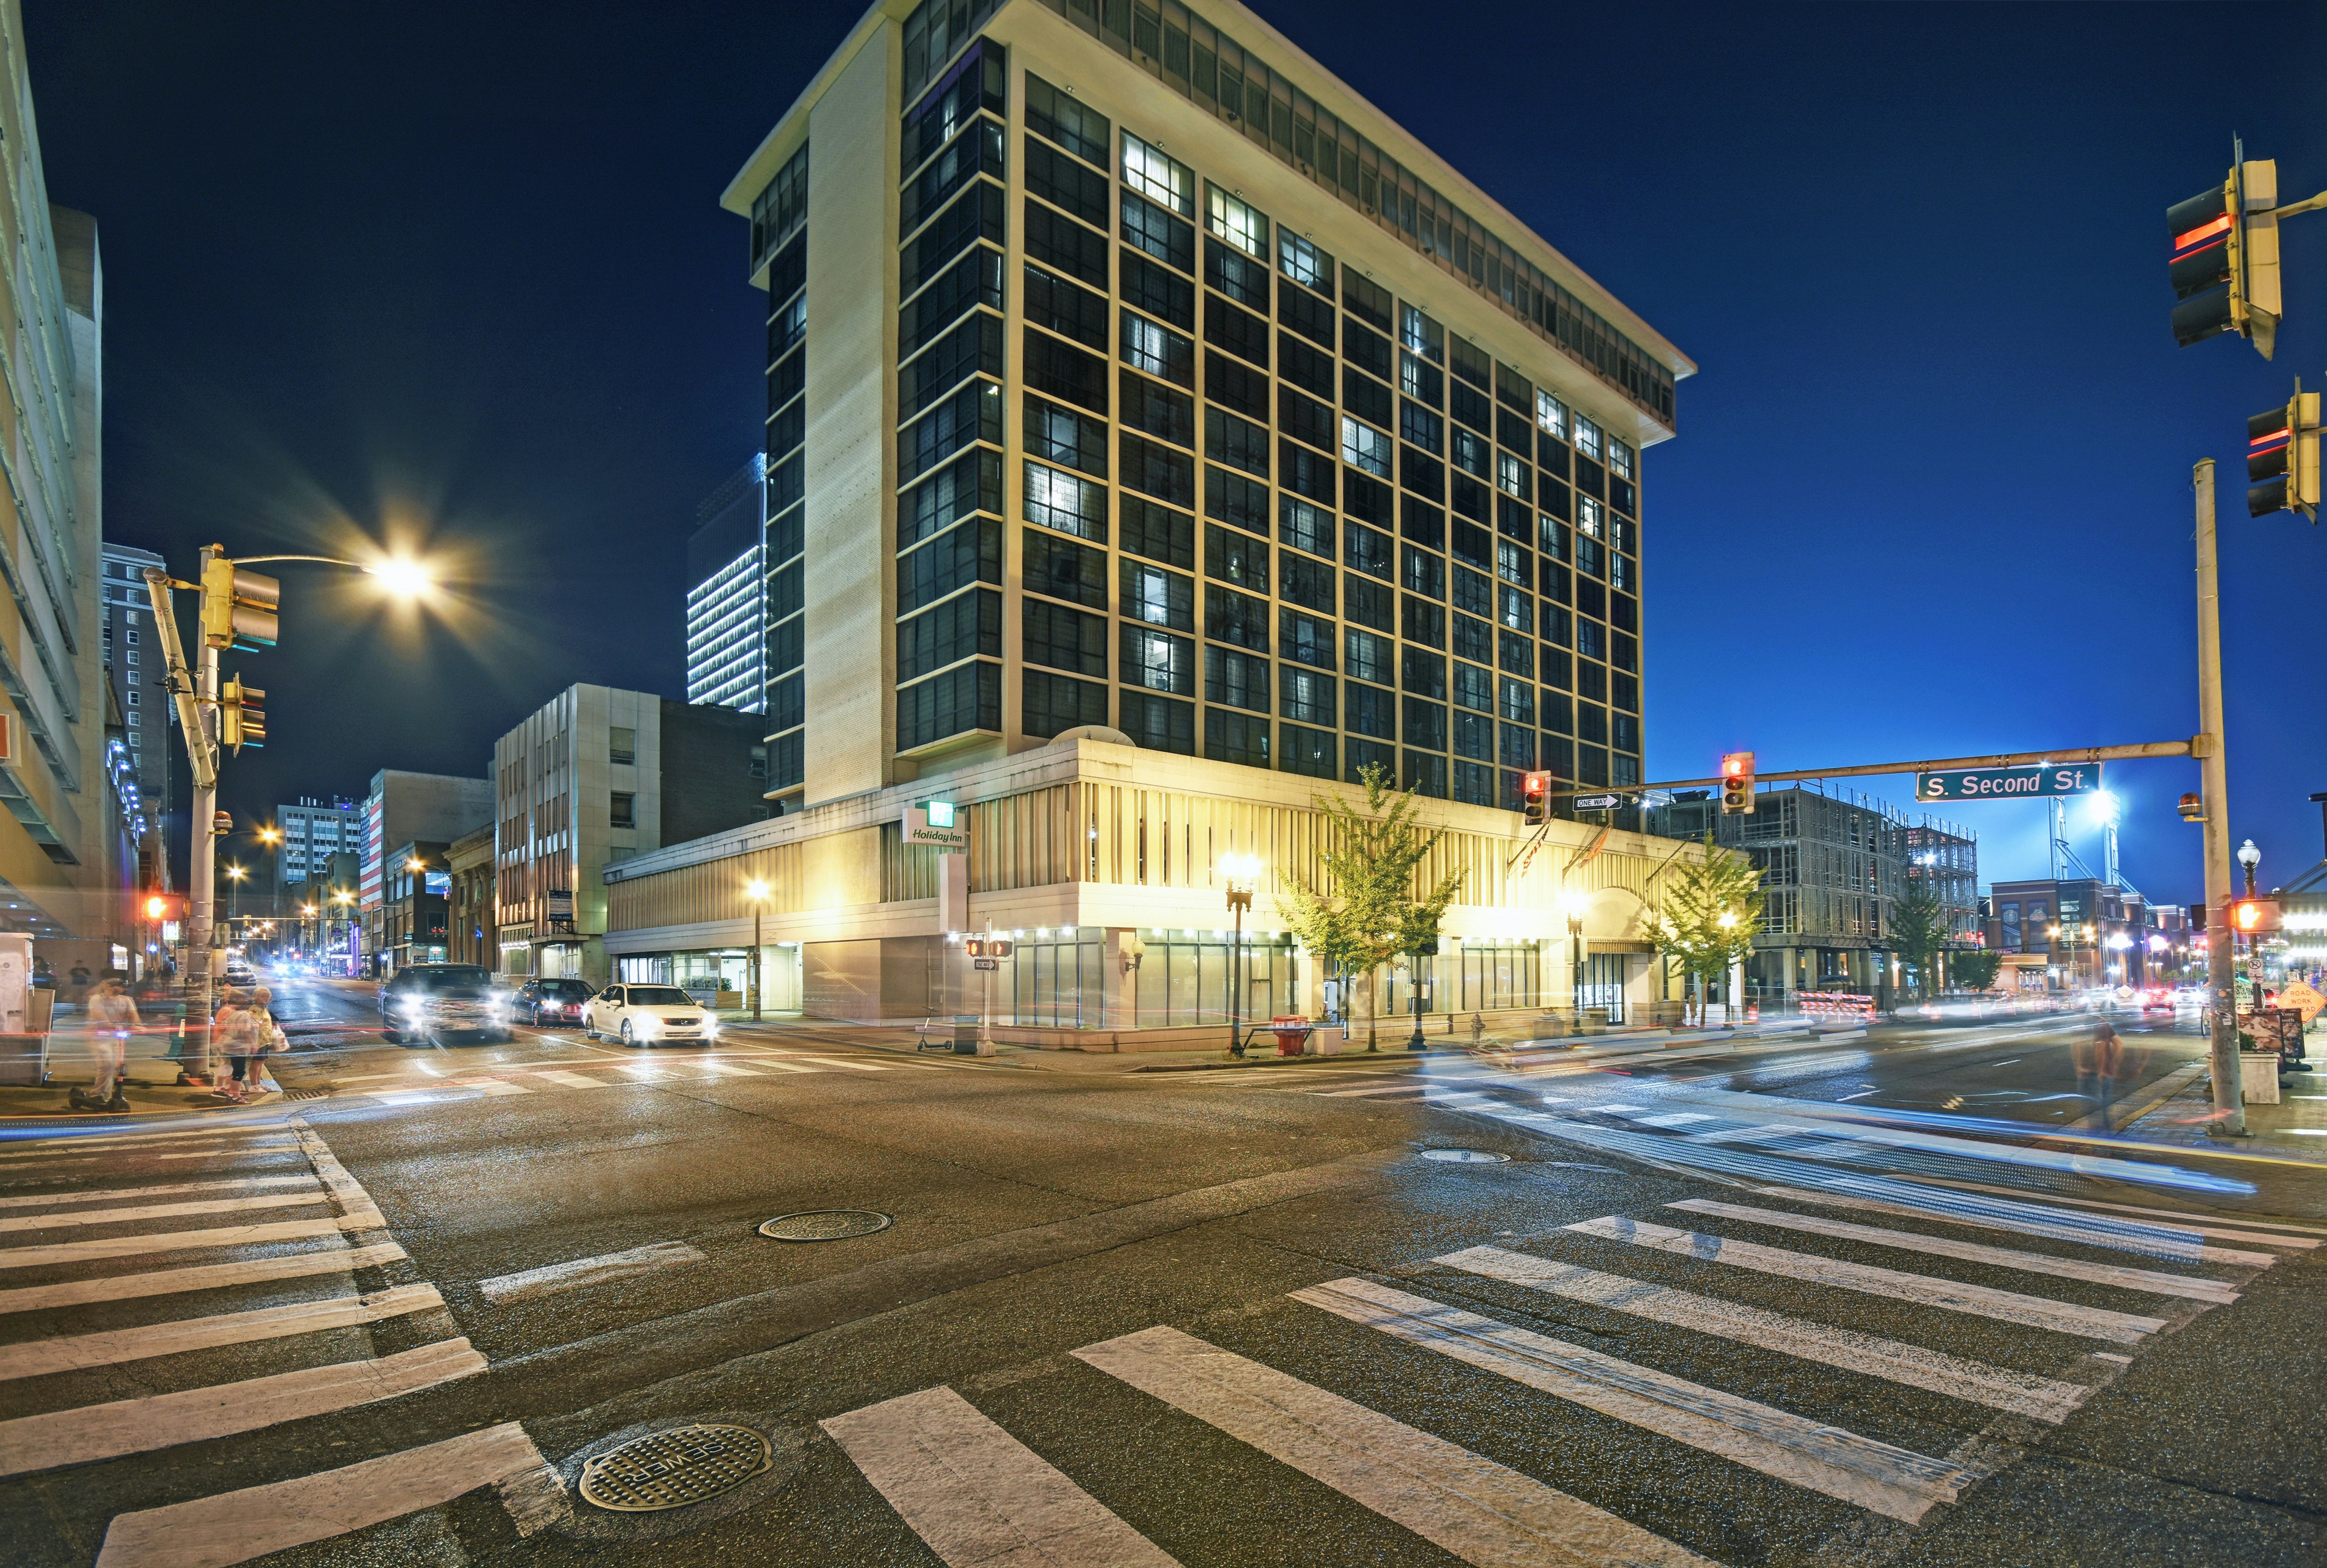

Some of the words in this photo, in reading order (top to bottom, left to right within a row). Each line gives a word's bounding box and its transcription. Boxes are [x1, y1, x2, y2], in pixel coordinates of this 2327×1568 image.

[1926, 777, 1949, 797] S.
[1961, 772, 2041, 795] Second
[2054, 770, 2089, 791] St.
[913, 829, 949, 843] Holiday
[950, 832, 962, 842] Inn
[627, 1442, 725, 1483] SEWER
